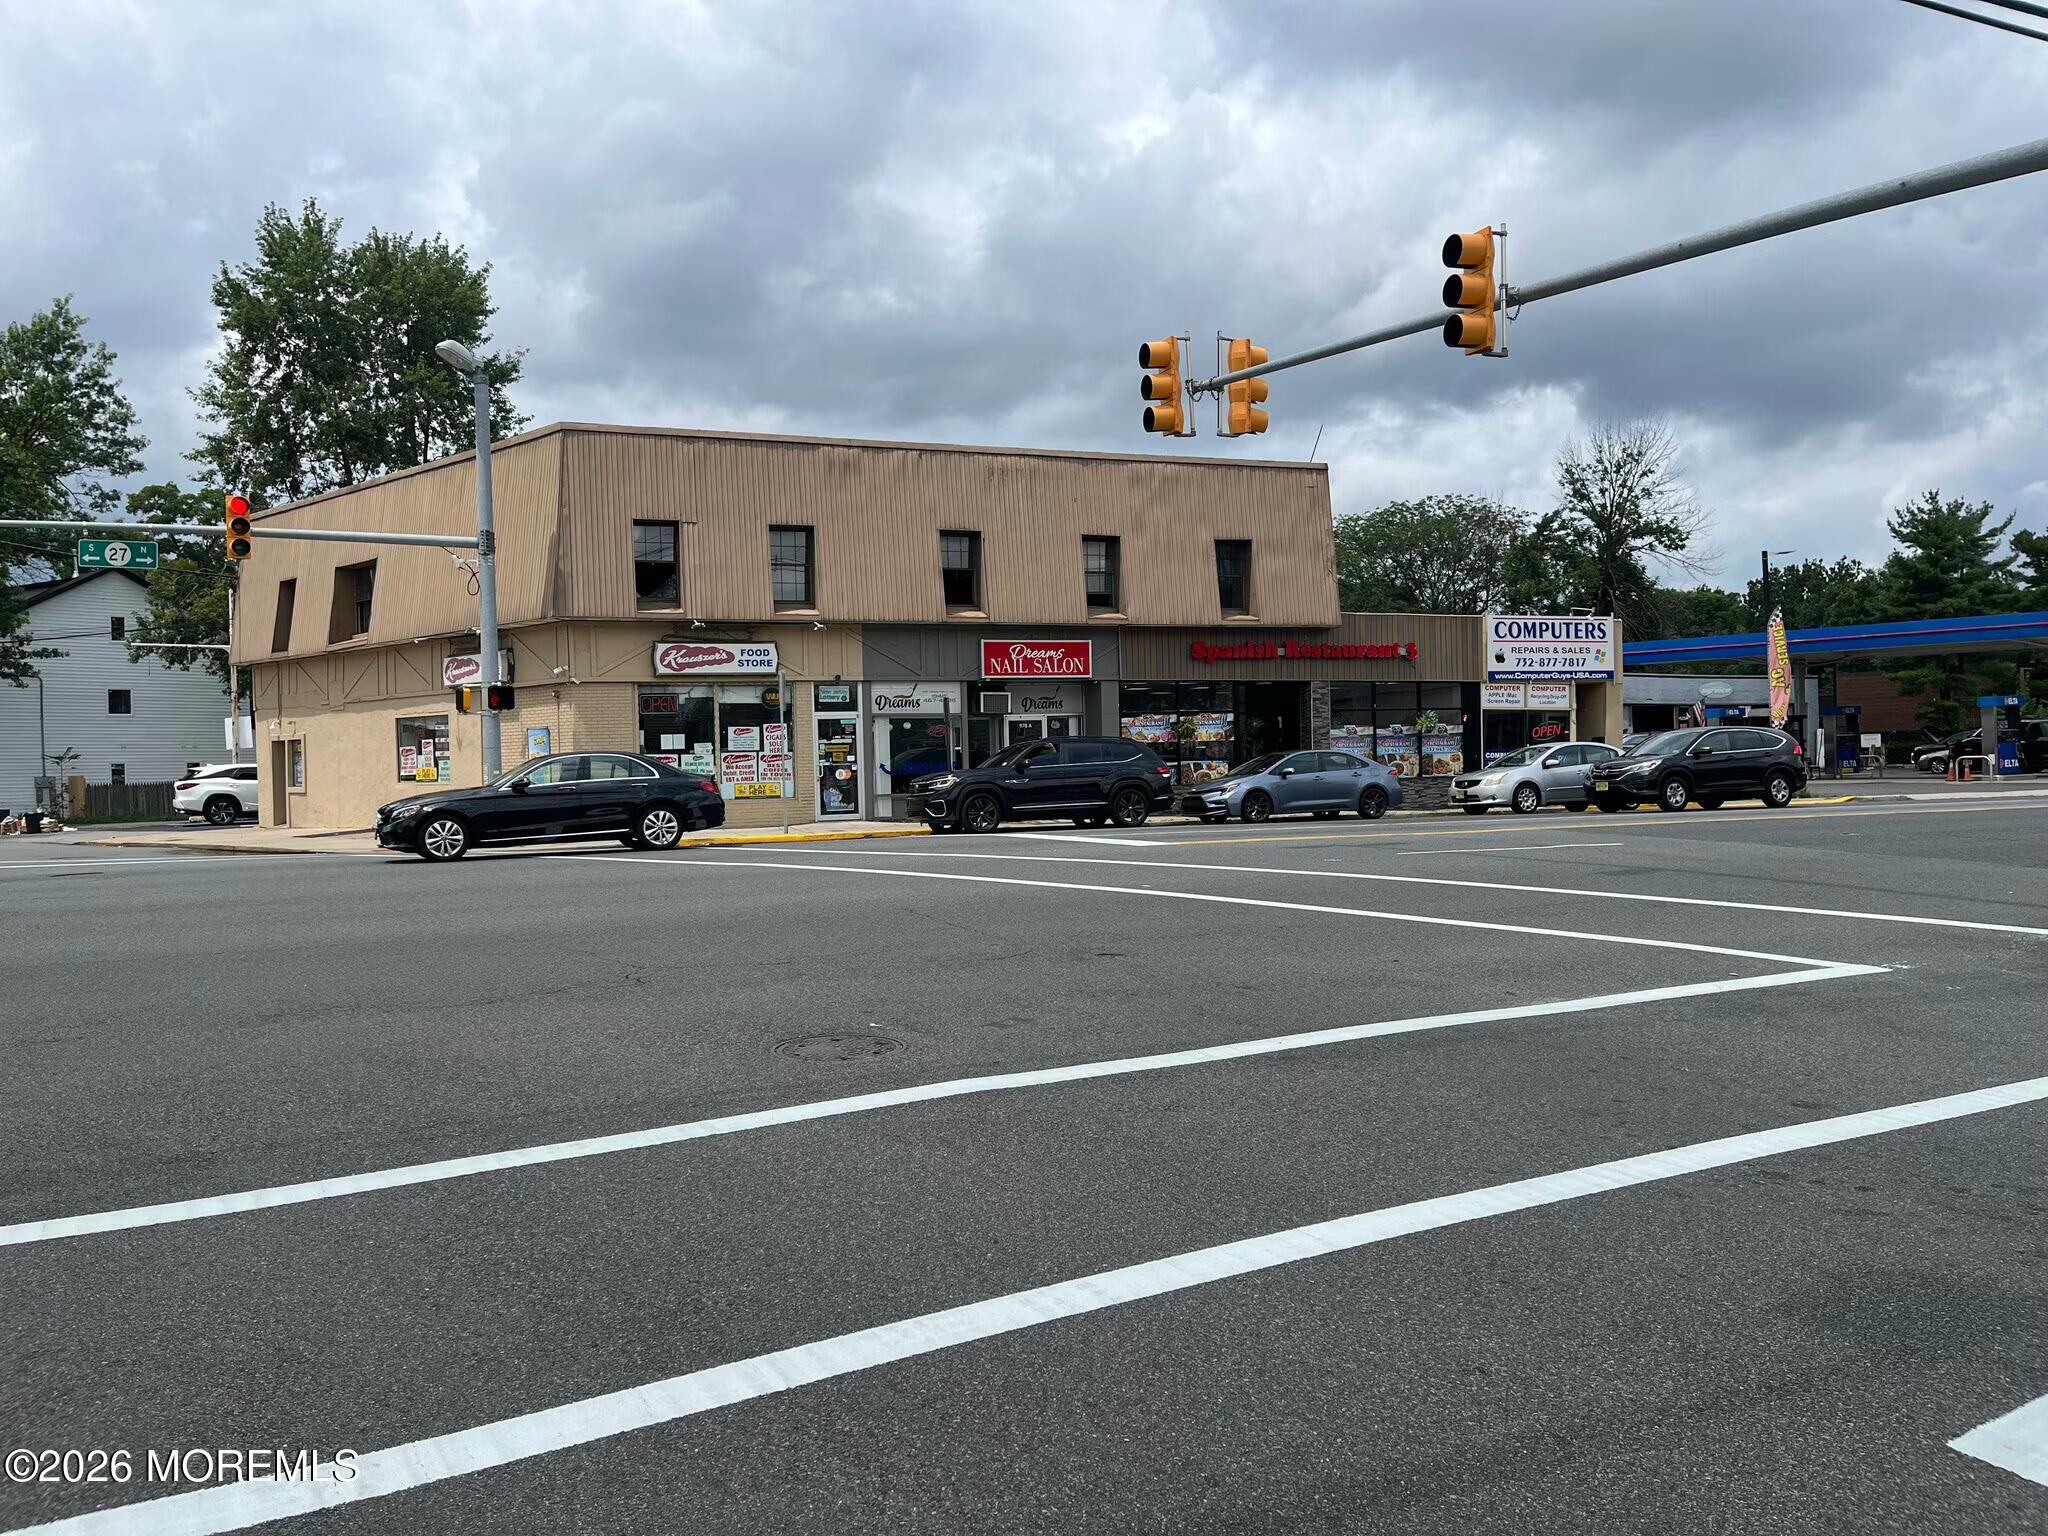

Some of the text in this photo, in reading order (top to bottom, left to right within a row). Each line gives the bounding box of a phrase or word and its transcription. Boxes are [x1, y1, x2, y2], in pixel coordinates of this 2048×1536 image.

[88, 543, 94, 551] S
[109, 547, 127, 561] 27
[1494, 621, 1607, 639] COMPUTERS
[1009, 644, 1065, 659] Dreams
[1191, 640, 1418, 663] Spanish Restaurant 3
[1511, 646, 1591, 654] REPAIRS & SALES
[1773, 623, 1789, 665] SERVICE
[740, 648, 770, 657] FOOD
[737, 659, 774, 668] STORE
[990, 657, 1084, 673] NAIL SALON
[1515, 657, 1587, 667] 732-877-7817
[1494, 672, 1608, 680] www.ComputerGuys-USA.com
[1771, 668, 1786, 688] AC
[641, 696, 678, 713] OPEN
[875, 695, 921, 711] Dreams
[1021, 697, 1063, 712] Dreams
[1532, 723, 1561, 738] OPEN
